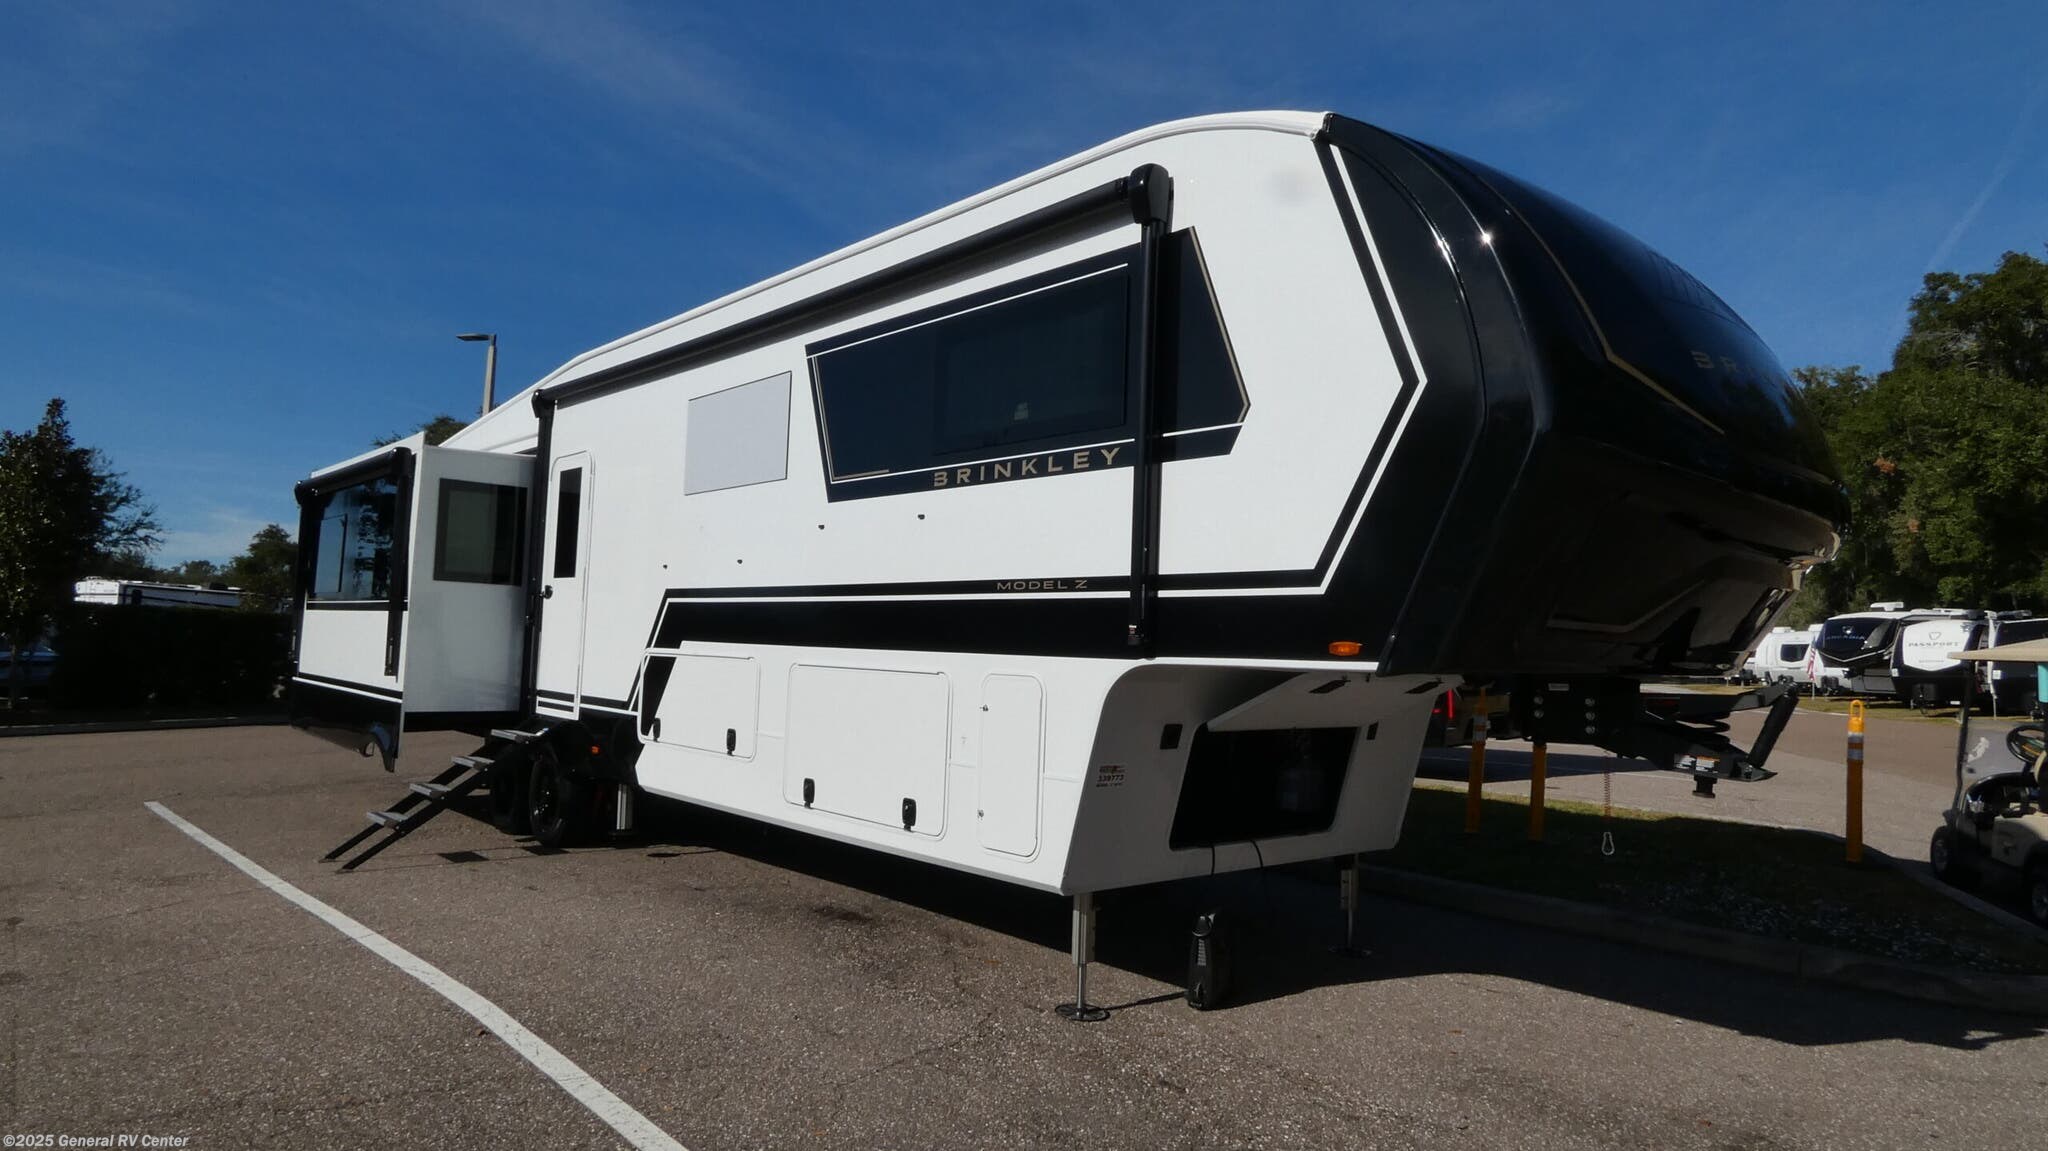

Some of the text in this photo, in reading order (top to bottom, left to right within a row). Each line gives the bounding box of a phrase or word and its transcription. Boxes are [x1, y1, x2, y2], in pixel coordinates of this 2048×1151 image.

[933, 447, 1121, 487] BRINKLEY
[996, 579, 1088, 590] MODEL Z
